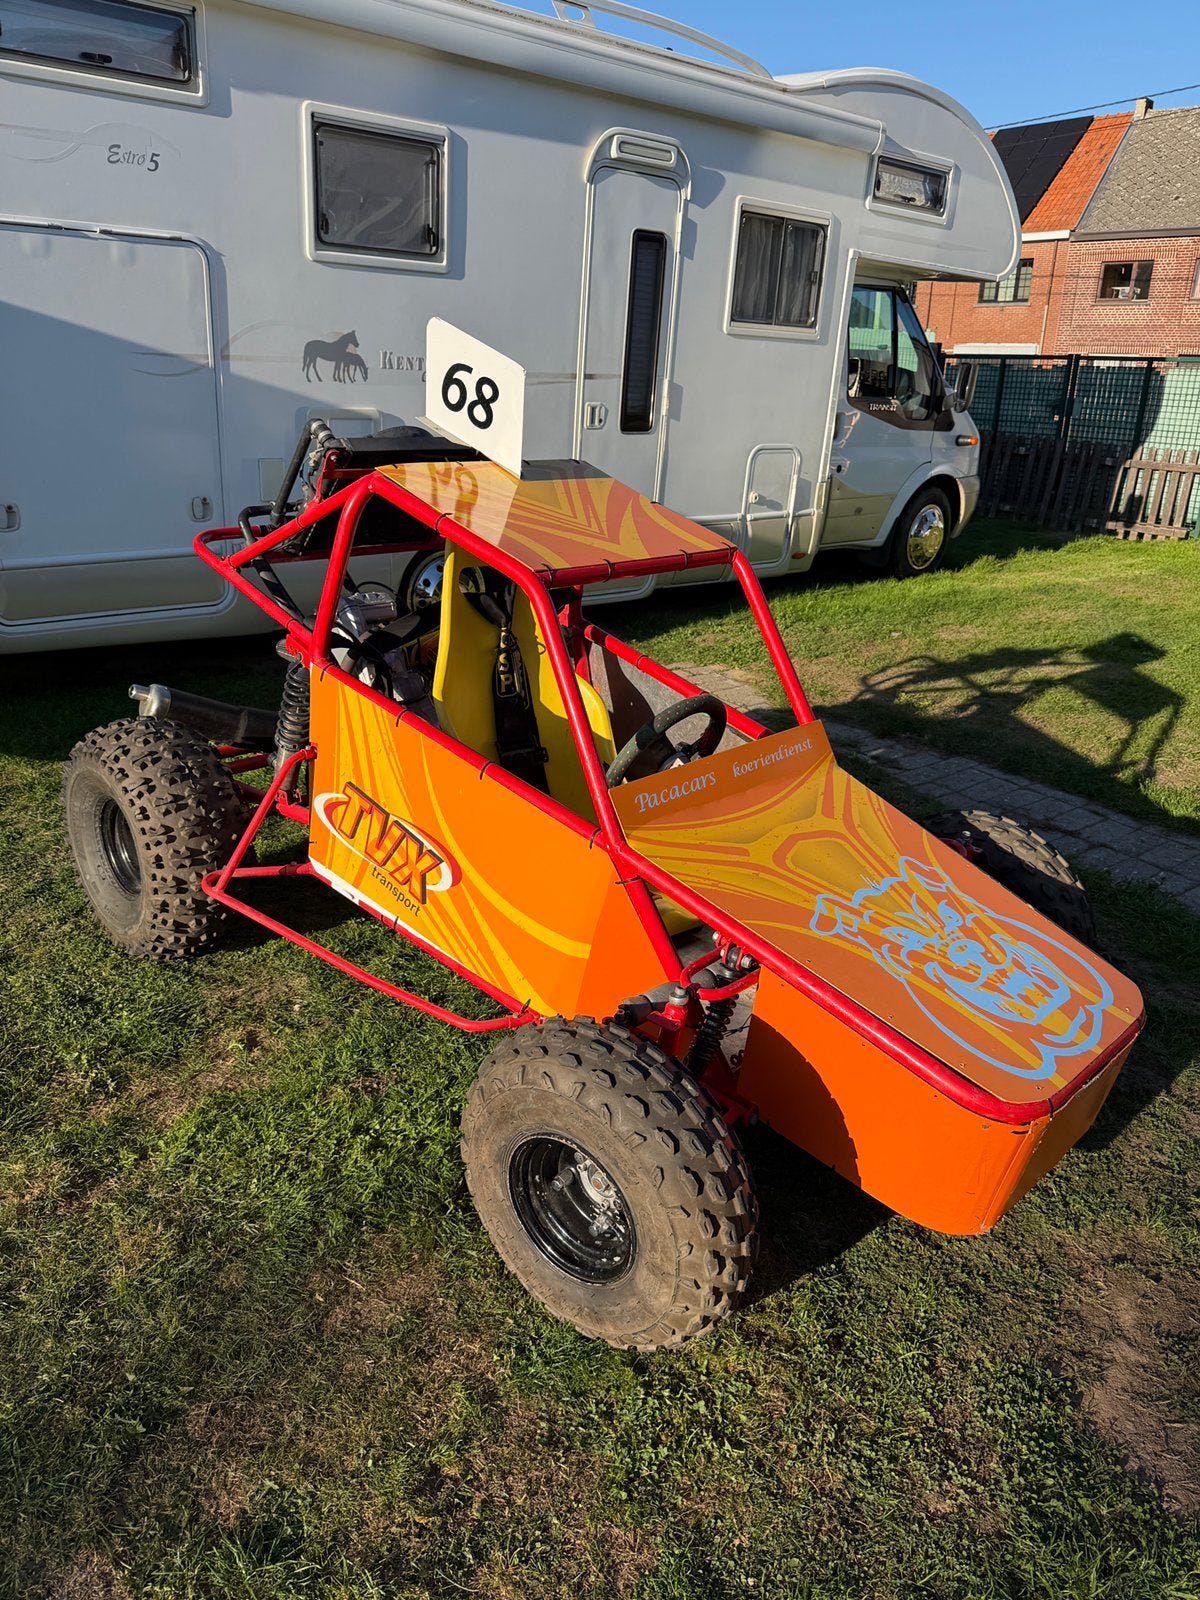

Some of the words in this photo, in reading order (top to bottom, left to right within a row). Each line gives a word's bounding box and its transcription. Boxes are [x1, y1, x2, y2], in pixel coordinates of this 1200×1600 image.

[107, 144, 146, 165] Estro
[147, 152, 160, 172] 5
[379, 350, 425, 371] KENT
[442, 363, 500, 430] 68
[869, 403, 897, 412] TRANSIT
[634, 772, 717, 813] Pacacars
[732, 738, 813, 778] koerierdienst
[338, 781, 445, 905] TVX
[371, 866, 421, 917] transport
